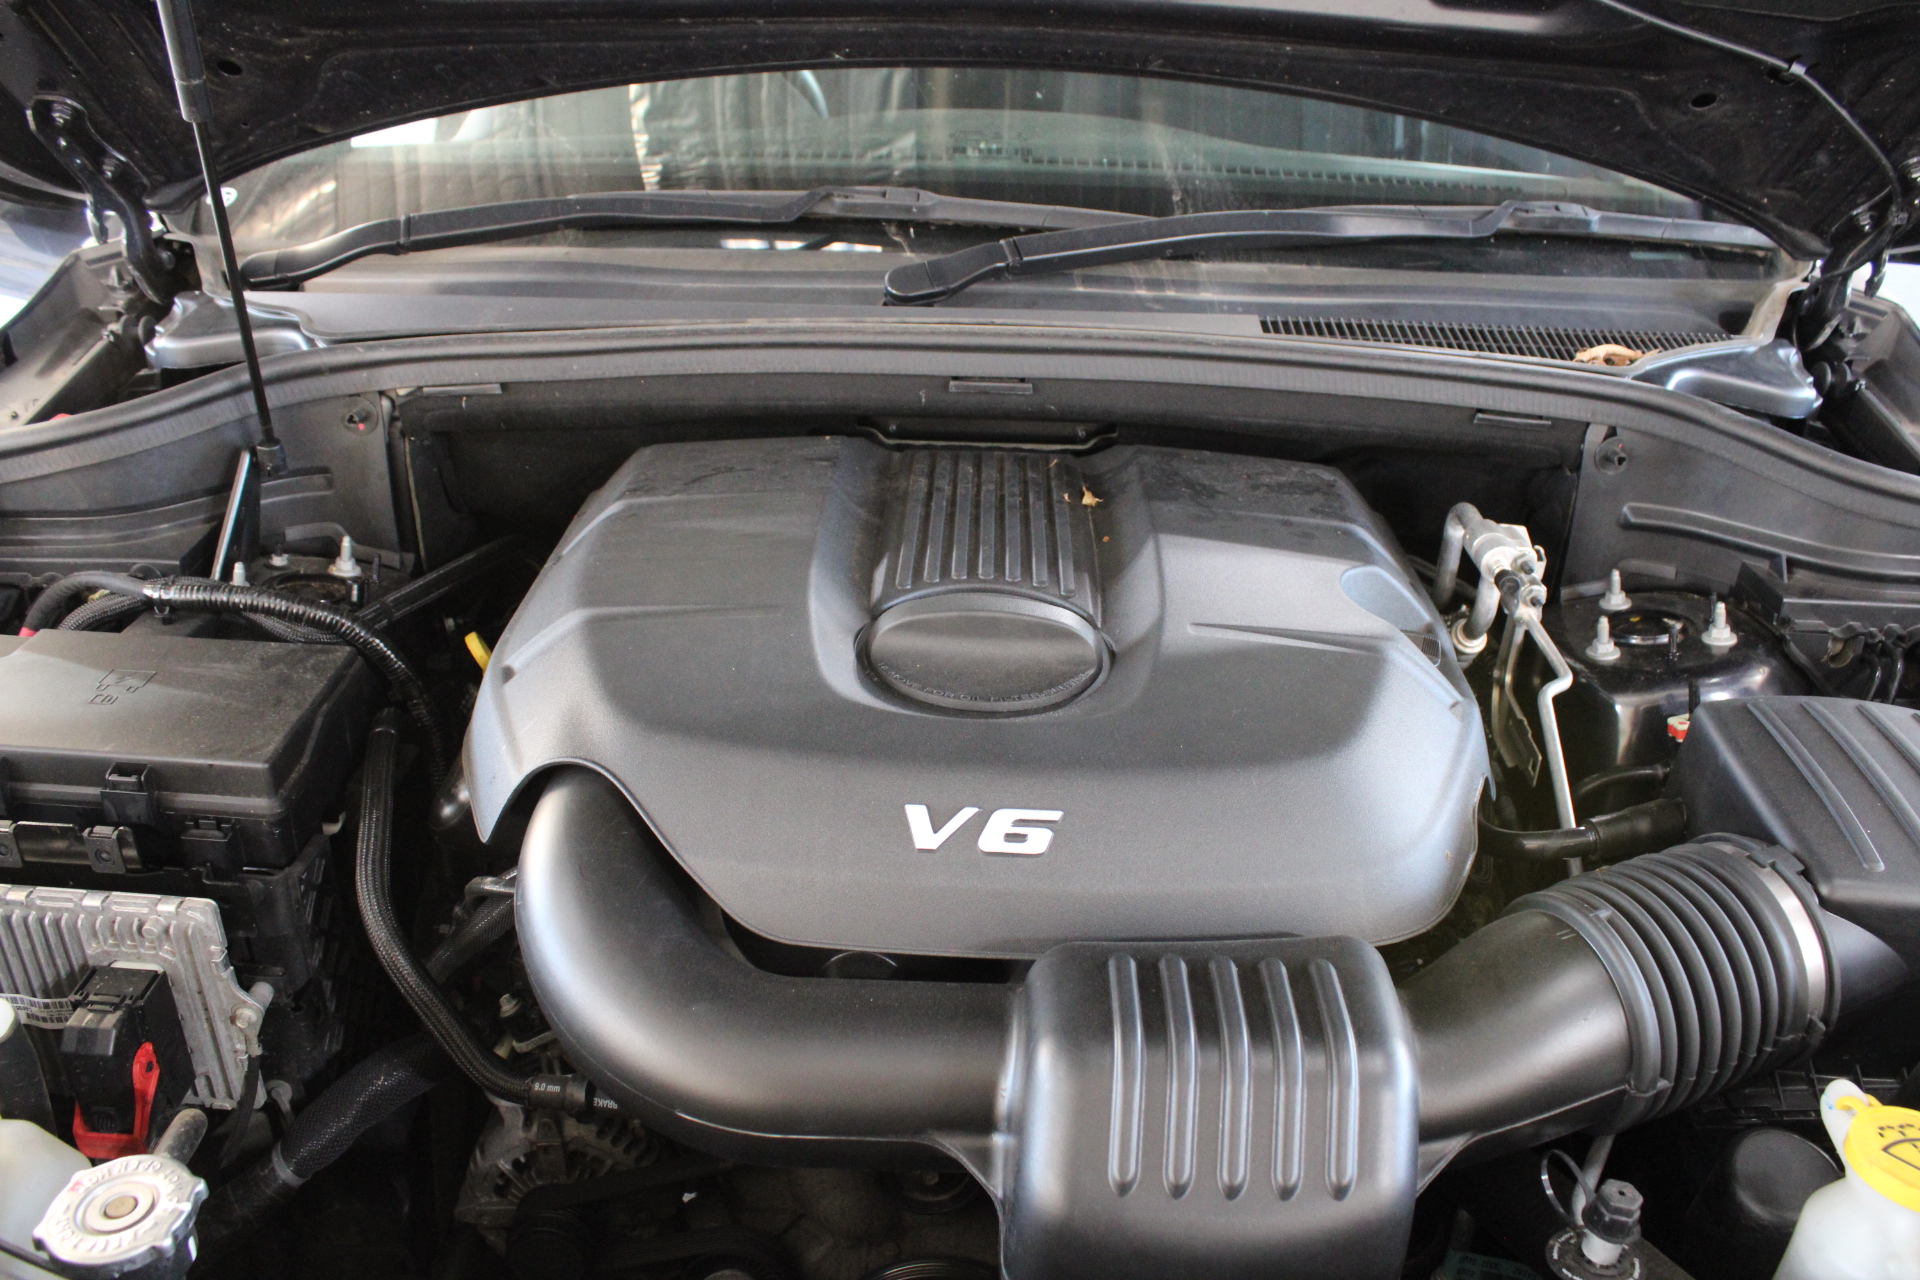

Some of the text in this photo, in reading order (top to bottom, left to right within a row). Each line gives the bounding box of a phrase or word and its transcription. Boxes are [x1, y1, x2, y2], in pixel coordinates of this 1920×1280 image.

[923, 687, 955, 699] FOR
[904, 804, 1064, 855] V6
[546, 1084, 561, 1093] mm
